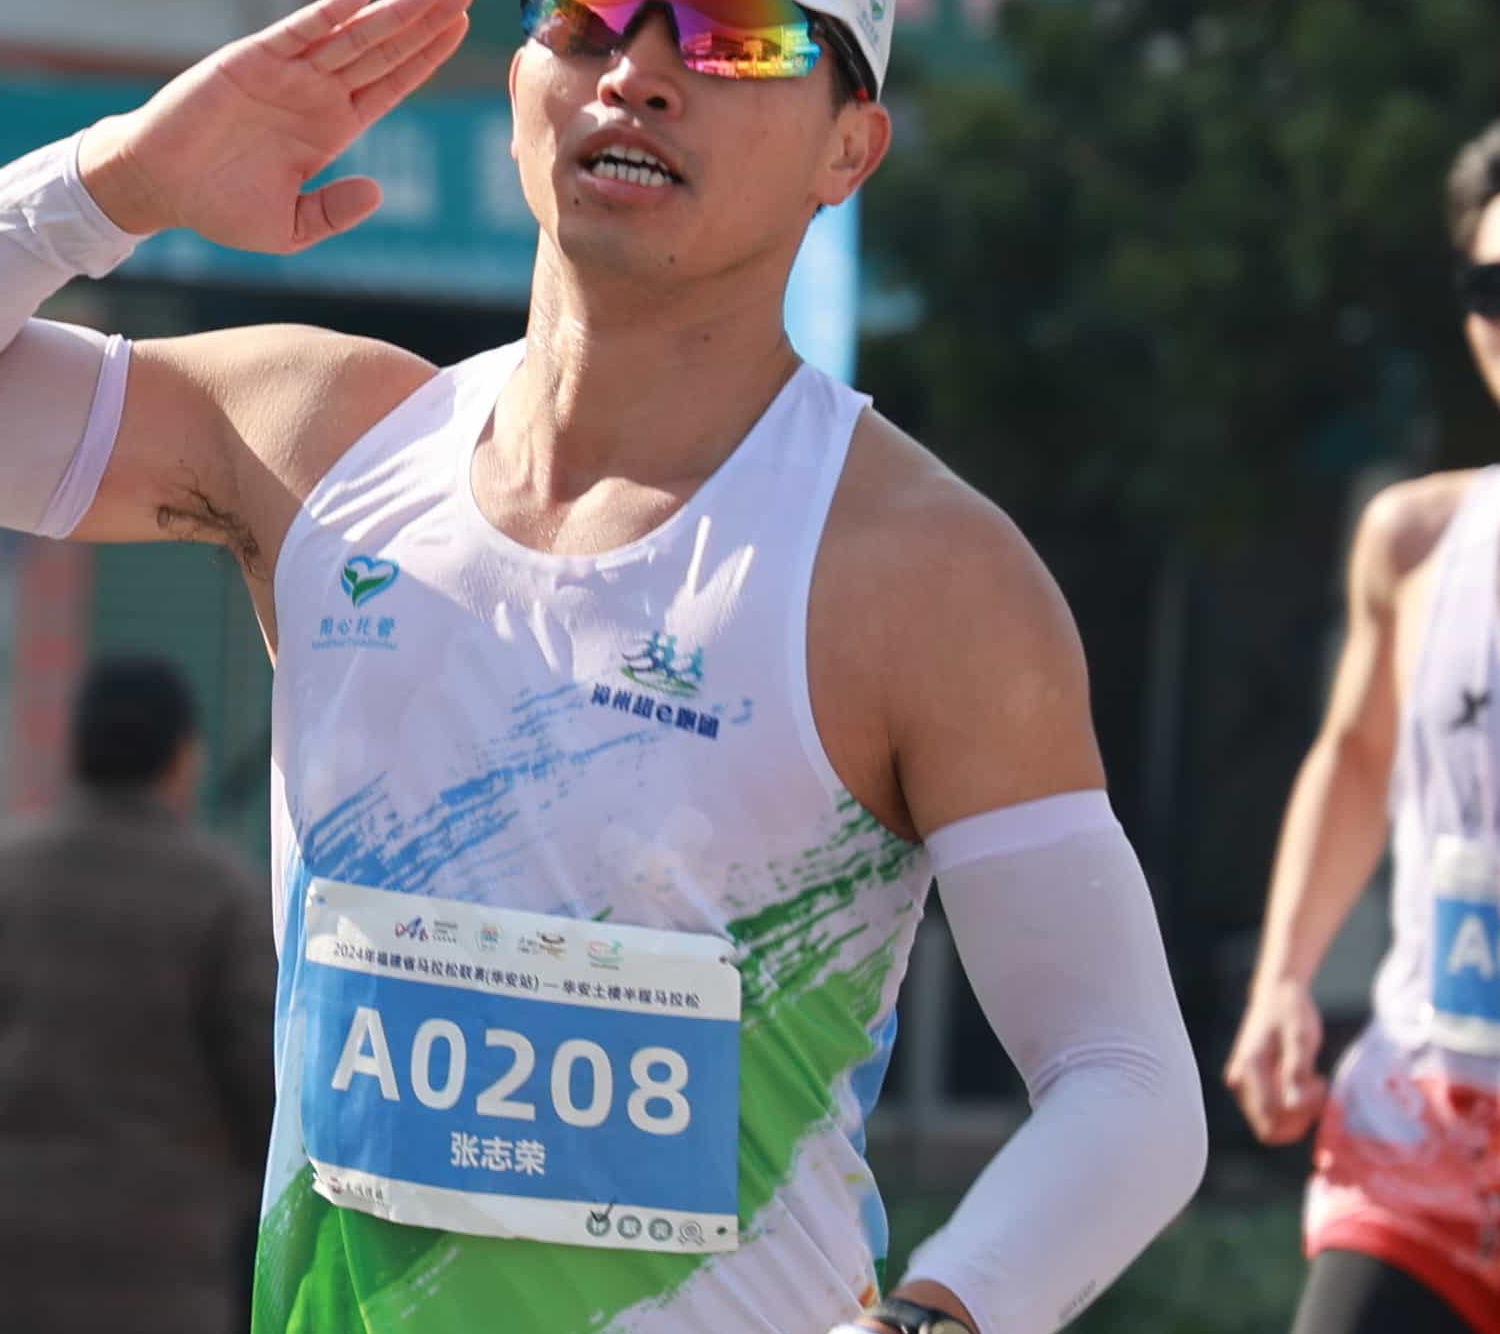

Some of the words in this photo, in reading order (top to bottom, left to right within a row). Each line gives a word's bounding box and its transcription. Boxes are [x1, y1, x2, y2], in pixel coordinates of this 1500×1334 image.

[330, 1005, 692, 1136] A0208
[450, 1130, 547, 1177] 张志荣
